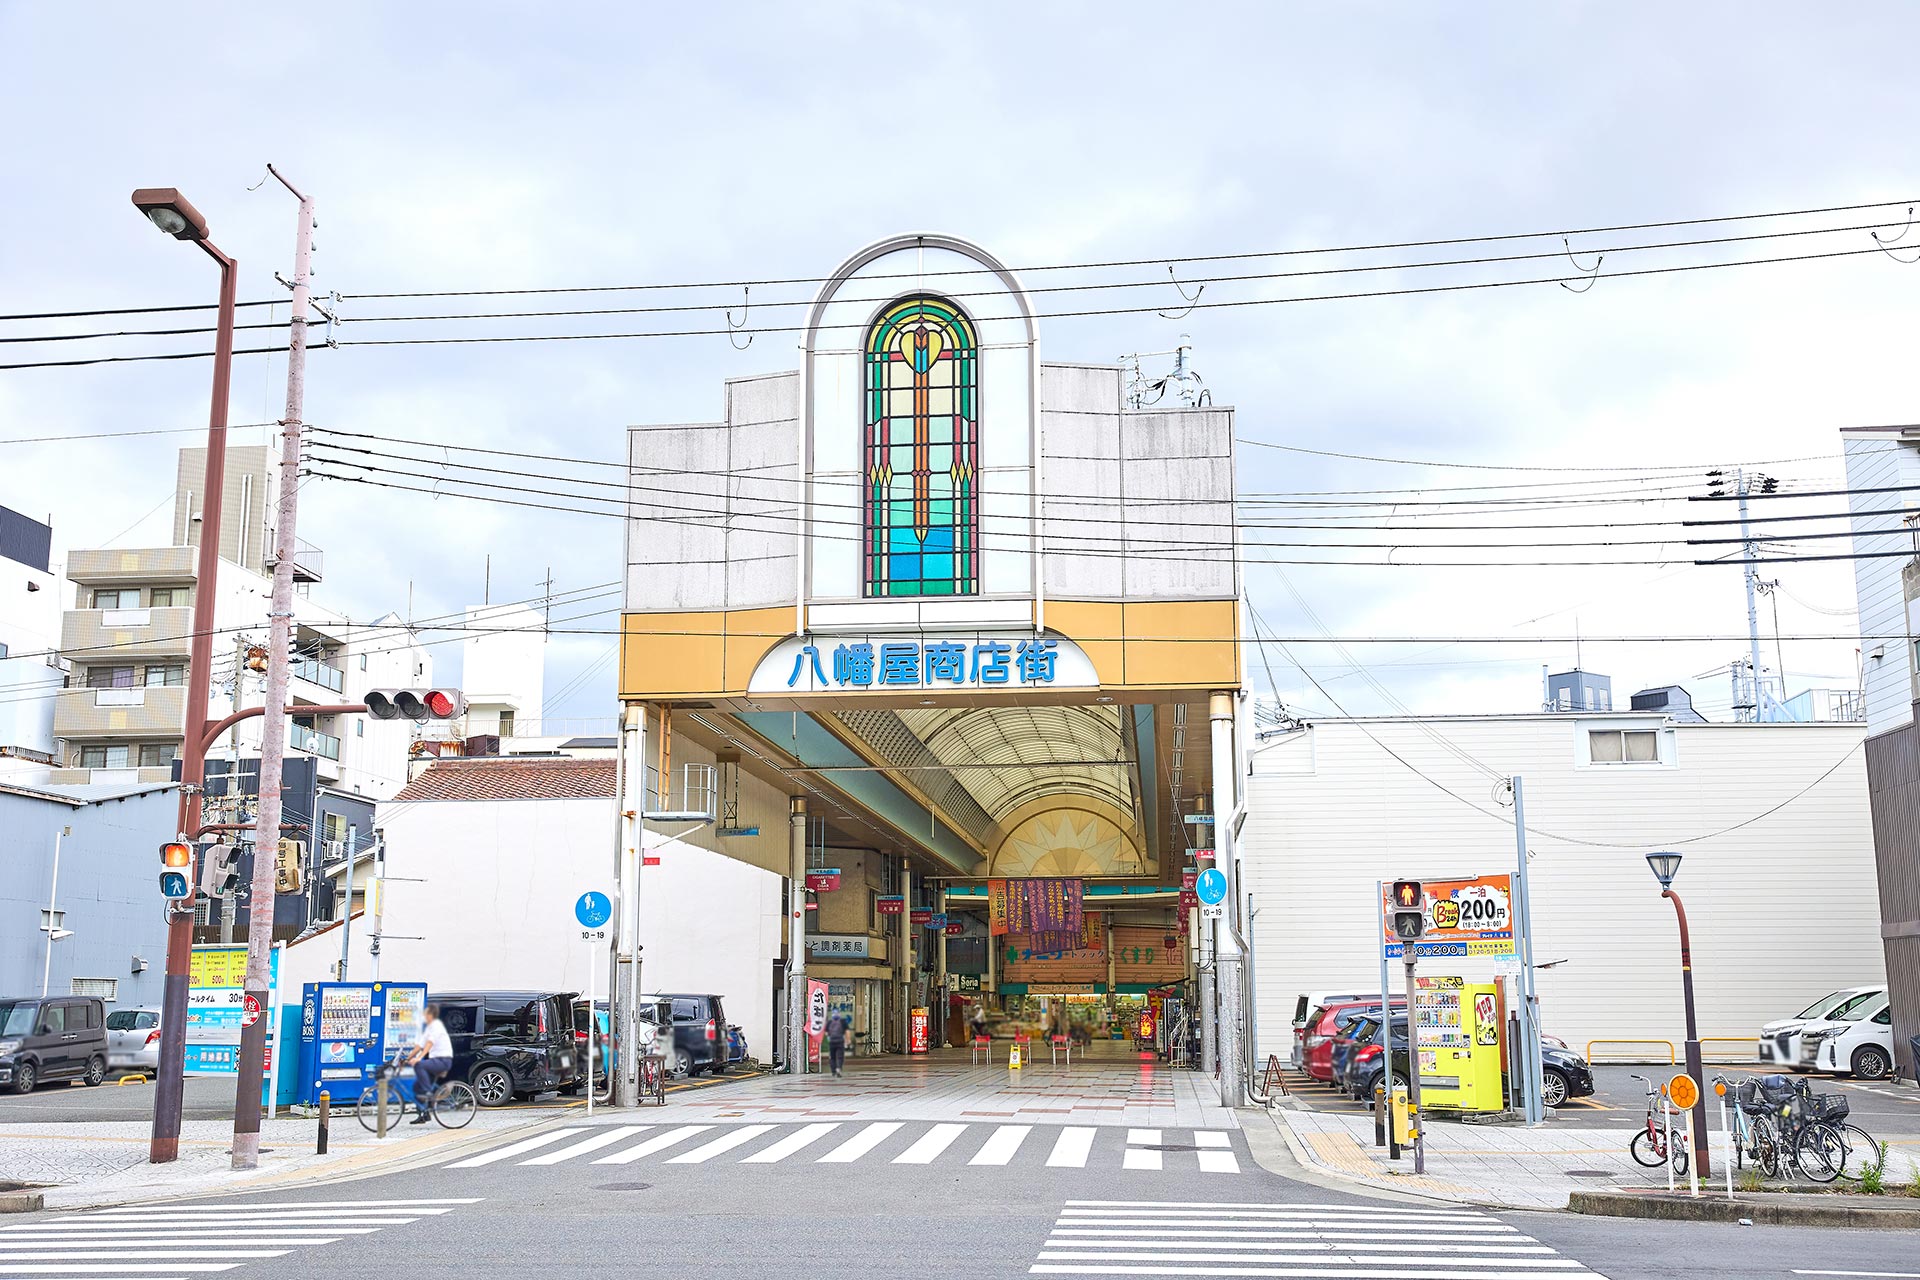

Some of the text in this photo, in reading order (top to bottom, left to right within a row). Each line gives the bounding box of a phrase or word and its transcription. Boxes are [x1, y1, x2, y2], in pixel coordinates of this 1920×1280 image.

[787, 640, 1059, 687] 八幡屋商店街
[1460, 899, 1506, 920] 200円
[1120, 946, 1155, 965] くすり
